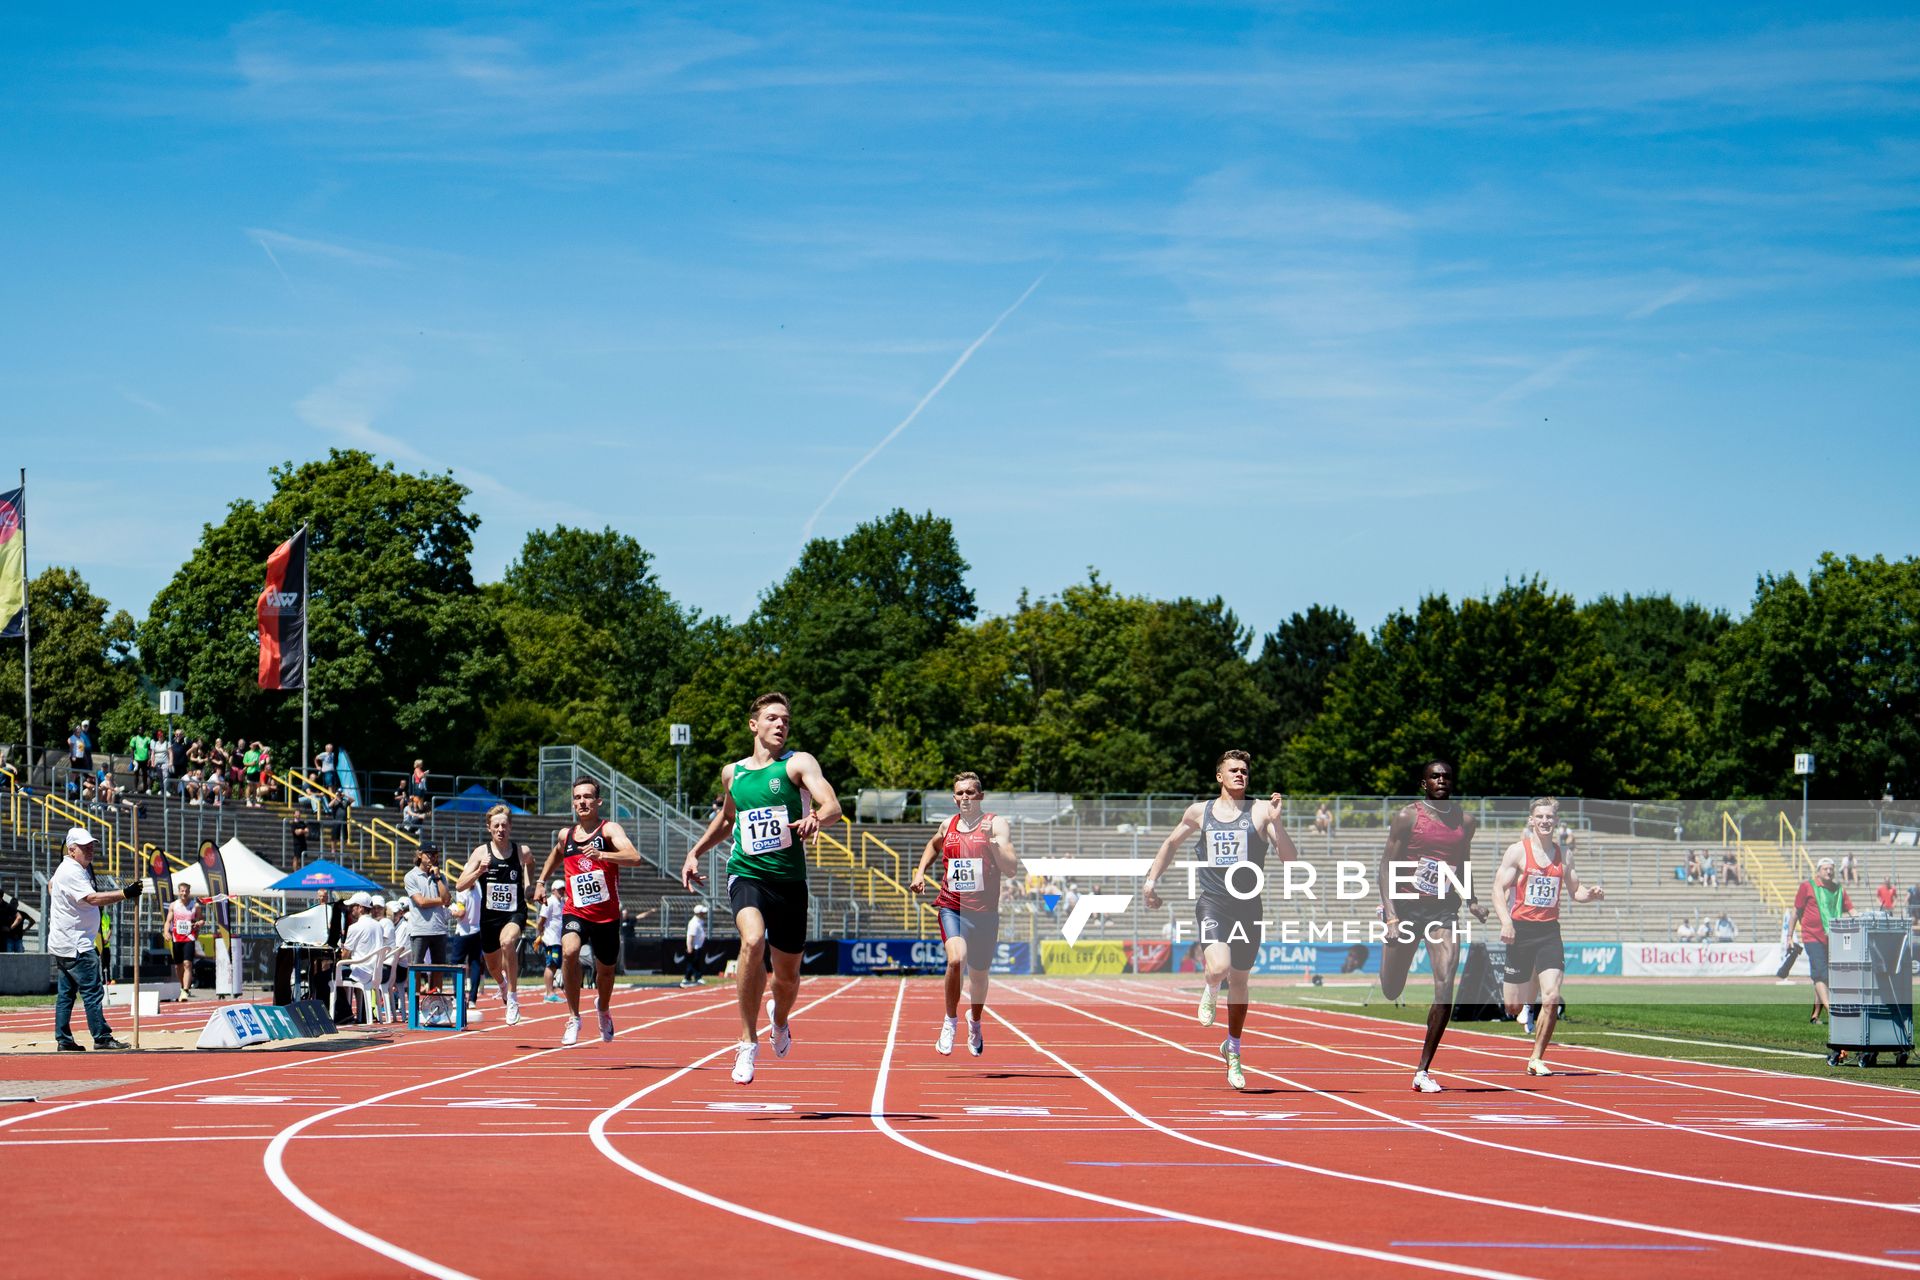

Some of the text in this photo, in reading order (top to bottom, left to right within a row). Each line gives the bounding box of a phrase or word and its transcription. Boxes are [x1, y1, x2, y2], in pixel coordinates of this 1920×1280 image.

[677, 727, 687, 741] H
[1797, 757, 1805, 769] H
[748, 820, 781, 839] 178
[763, 839, 780, 847] PLAN
[1214, 832, 1235, 841] GLS
[1213, 841, 1240, 855] 157
[954, 860, 972, 868] GLS
[576, 873, 593, 884] GLS
[952, 868, 975, 881] 461
[1535, 877, 1552, 885] GLS
[577, 880, 601, 896] 596
[1528, 884, 1556, 898] 1131
[491, 893, 512, 903] 859
[1048, 953, 1072, 964] VIEL
[1270, 946, 1317, 962] PLAN
[1581, 947, 1616, 972] wgv
[1641, 947, 1755, 964] Black Forest
